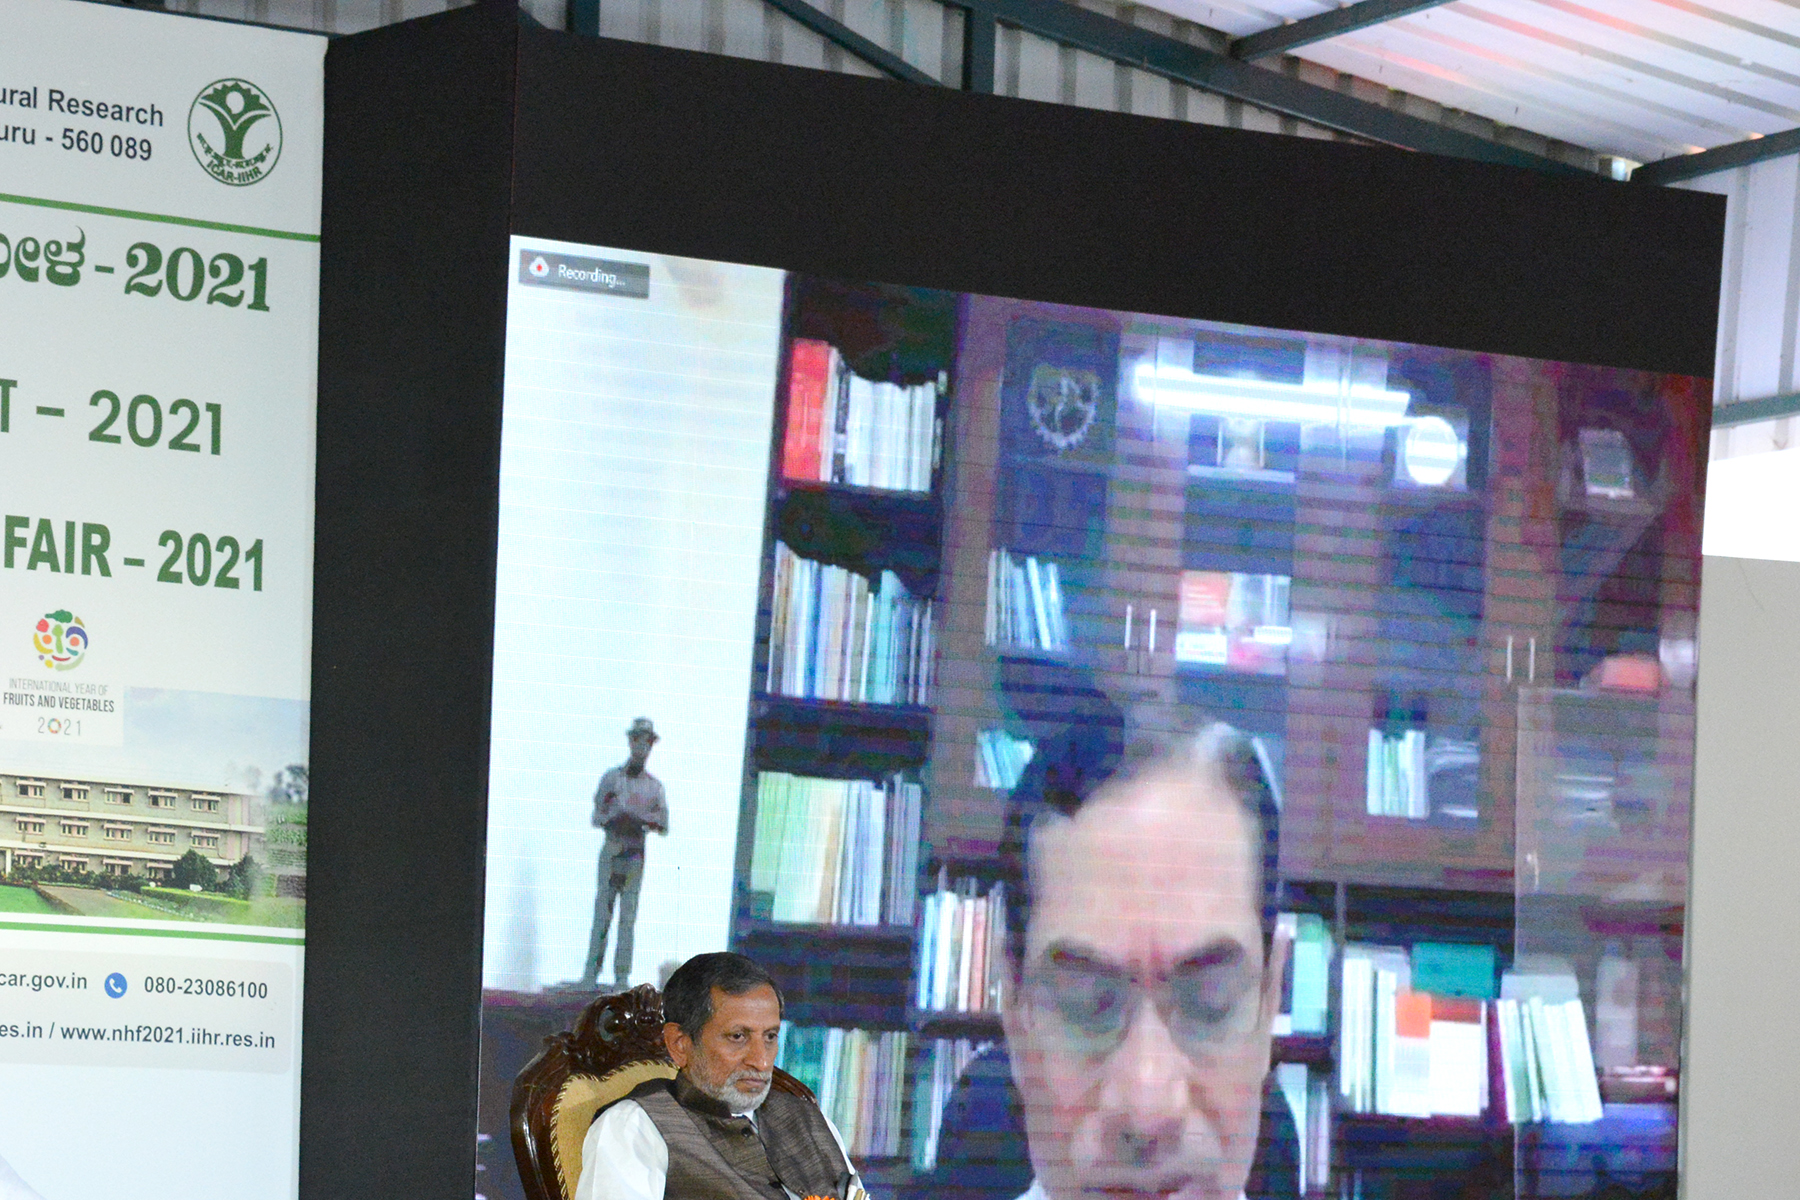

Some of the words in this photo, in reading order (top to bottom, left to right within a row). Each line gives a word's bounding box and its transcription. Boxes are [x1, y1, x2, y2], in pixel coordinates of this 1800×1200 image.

[48, 88, 164, 127] Research
[61, 127, 103, 155] 560
[110, 134, 153, 161] 089
[206, 159, 263, 183] ICAR-IIHR
[88, 389, 223, 456] 2021
[8, 678, 72, 694] INTERNATIONAL
[75, 682, 97, 696] YEAR
[97, 684, 109, 696] OF
[3, 691, 36, 707] FRUITS
[37, 694, 56, 709] AND
[58, 696, 115, 713] VEGETABLES
[143, 976, 268, 1000] 080-23086100
[60, 1025, 276, 1049] www.nhf2021.iihr.res.in
